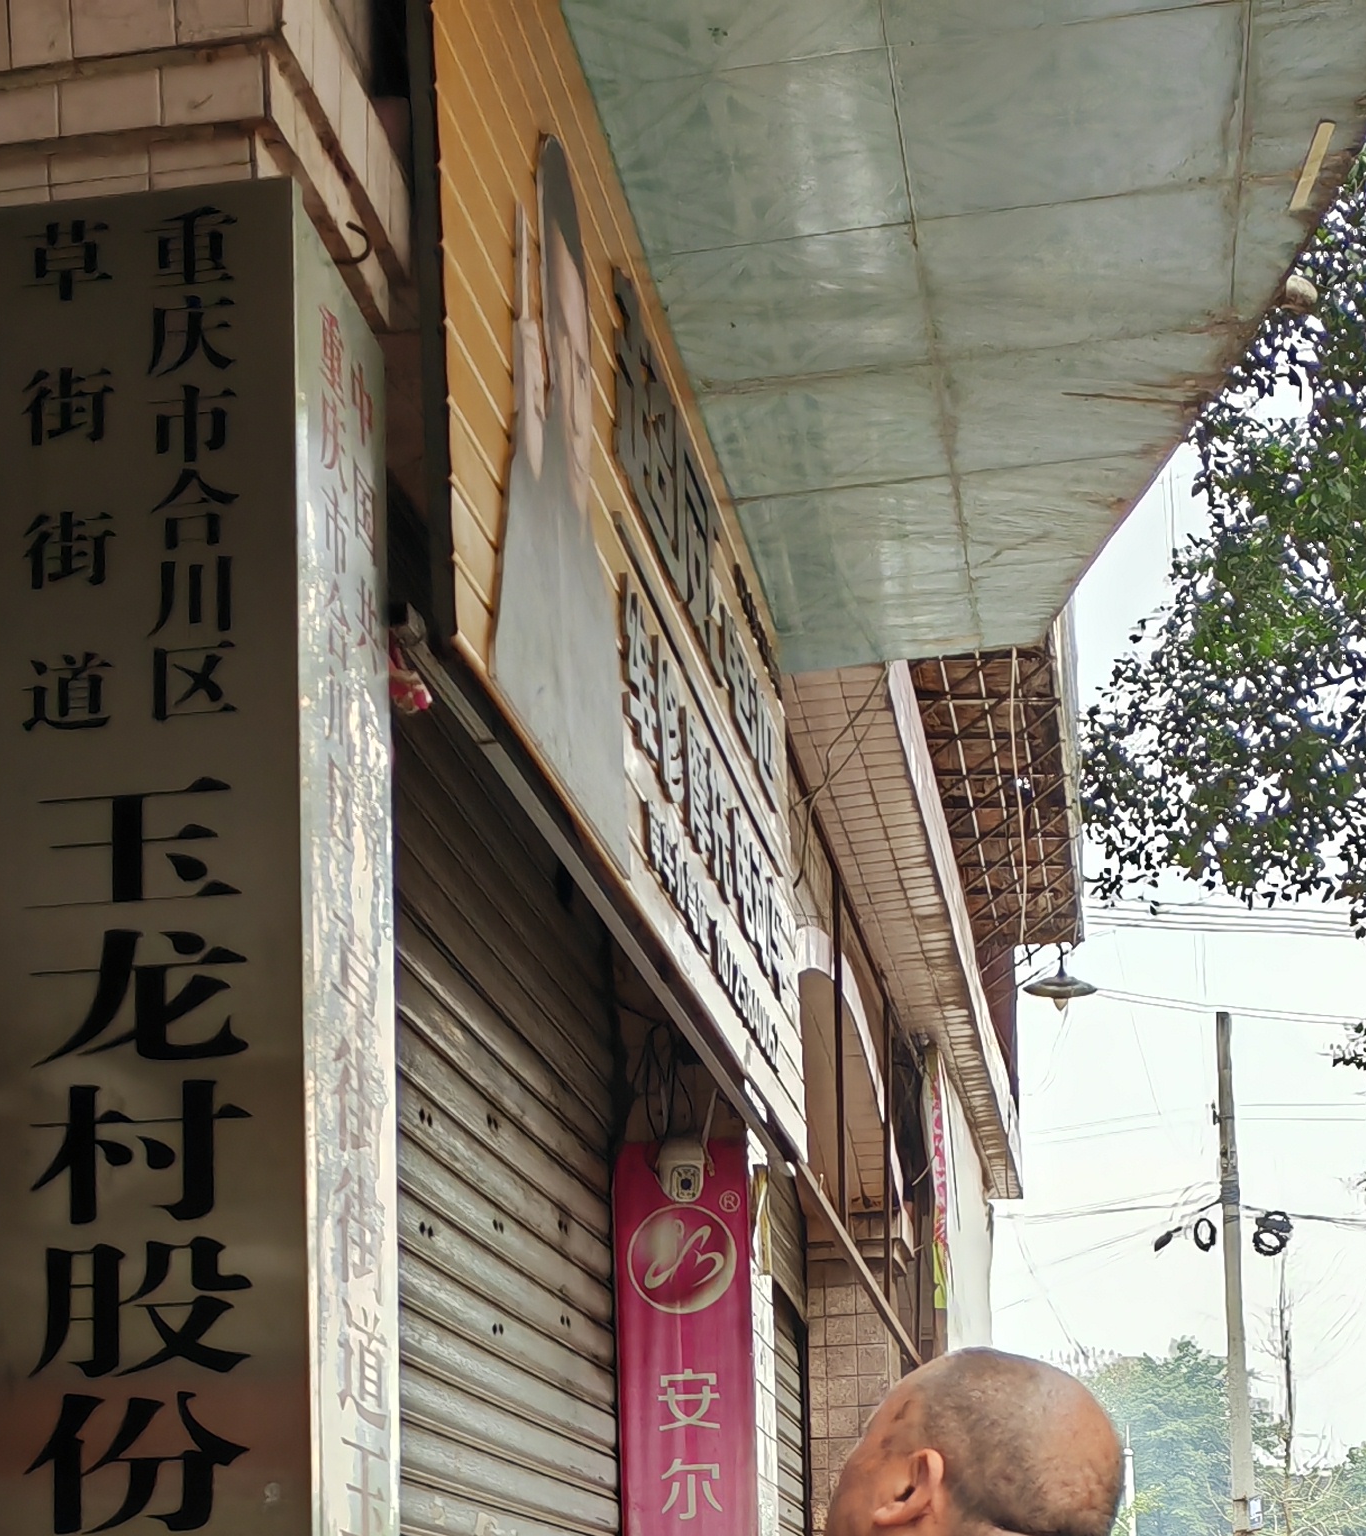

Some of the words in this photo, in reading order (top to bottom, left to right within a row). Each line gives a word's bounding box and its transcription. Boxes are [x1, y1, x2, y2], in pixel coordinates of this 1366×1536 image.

[22, 219, 115, 733] 草街街道
[143, 206, 240, 723] 重庆市合川区
